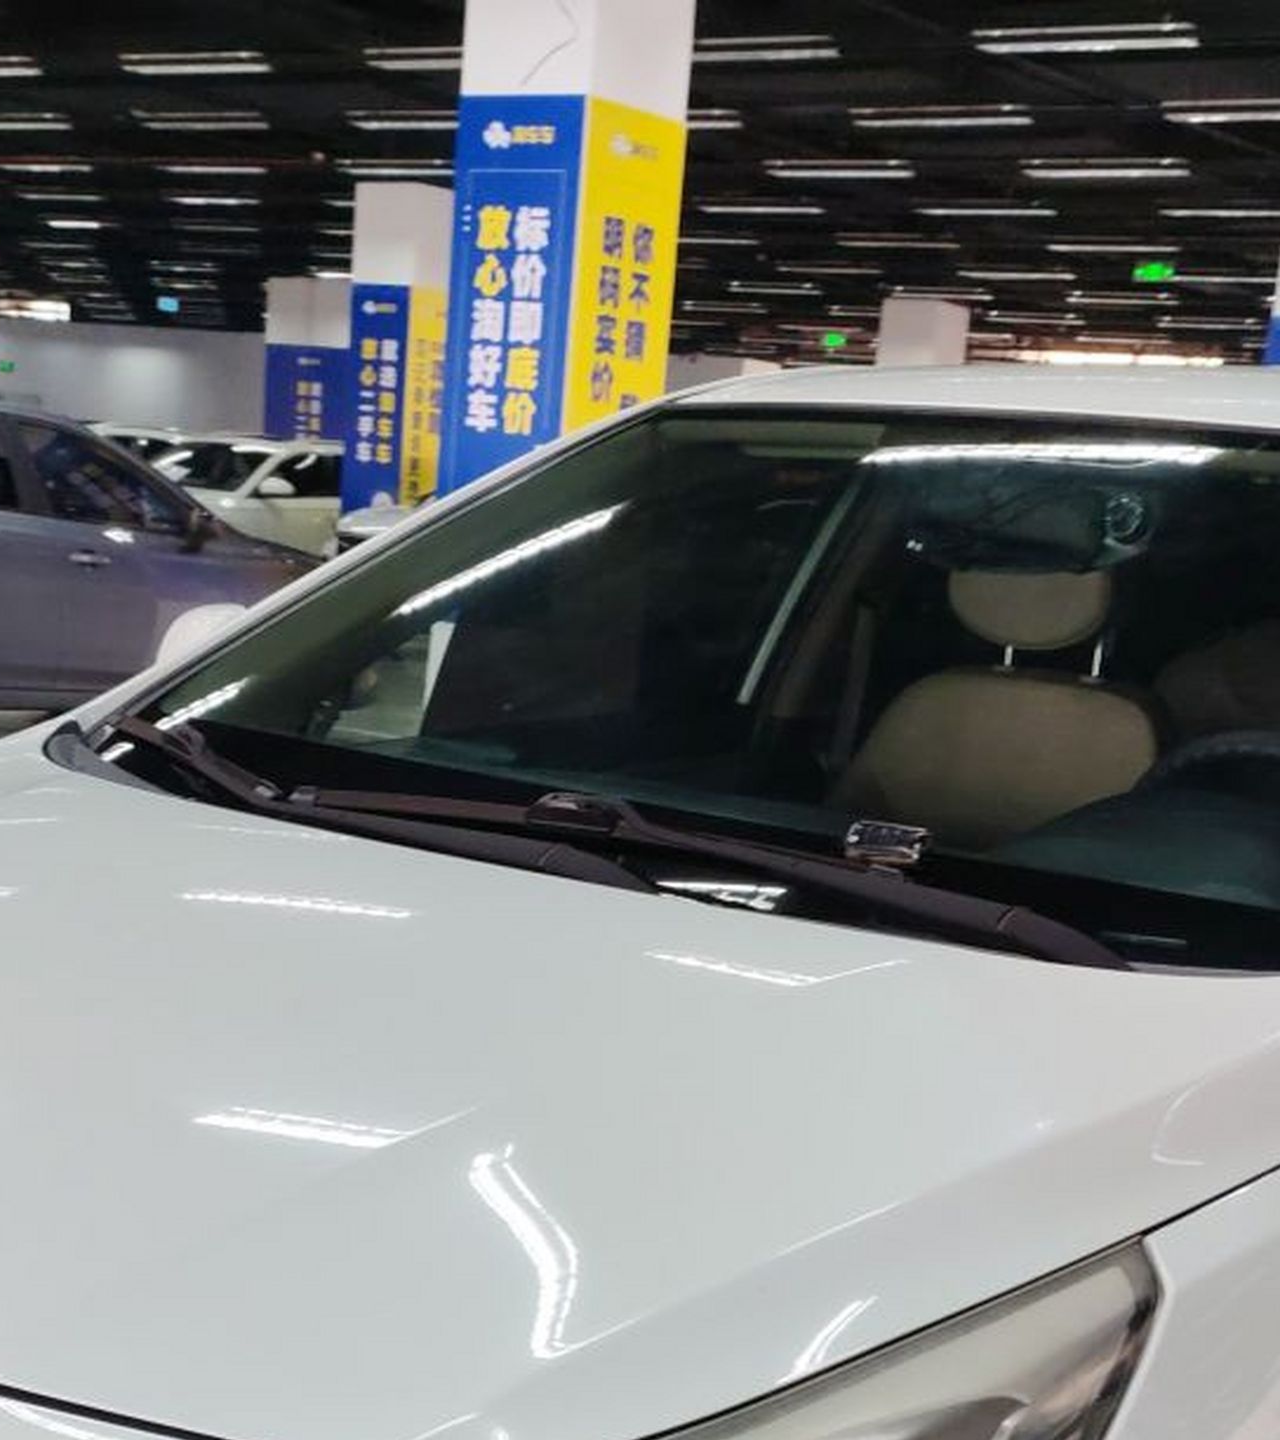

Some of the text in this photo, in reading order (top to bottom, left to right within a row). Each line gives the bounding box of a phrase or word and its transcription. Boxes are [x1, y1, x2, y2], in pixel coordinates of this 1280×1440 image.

[502, 206, 551, 435] 标价即底价
[590, 216, 625, 402] 明码实价
